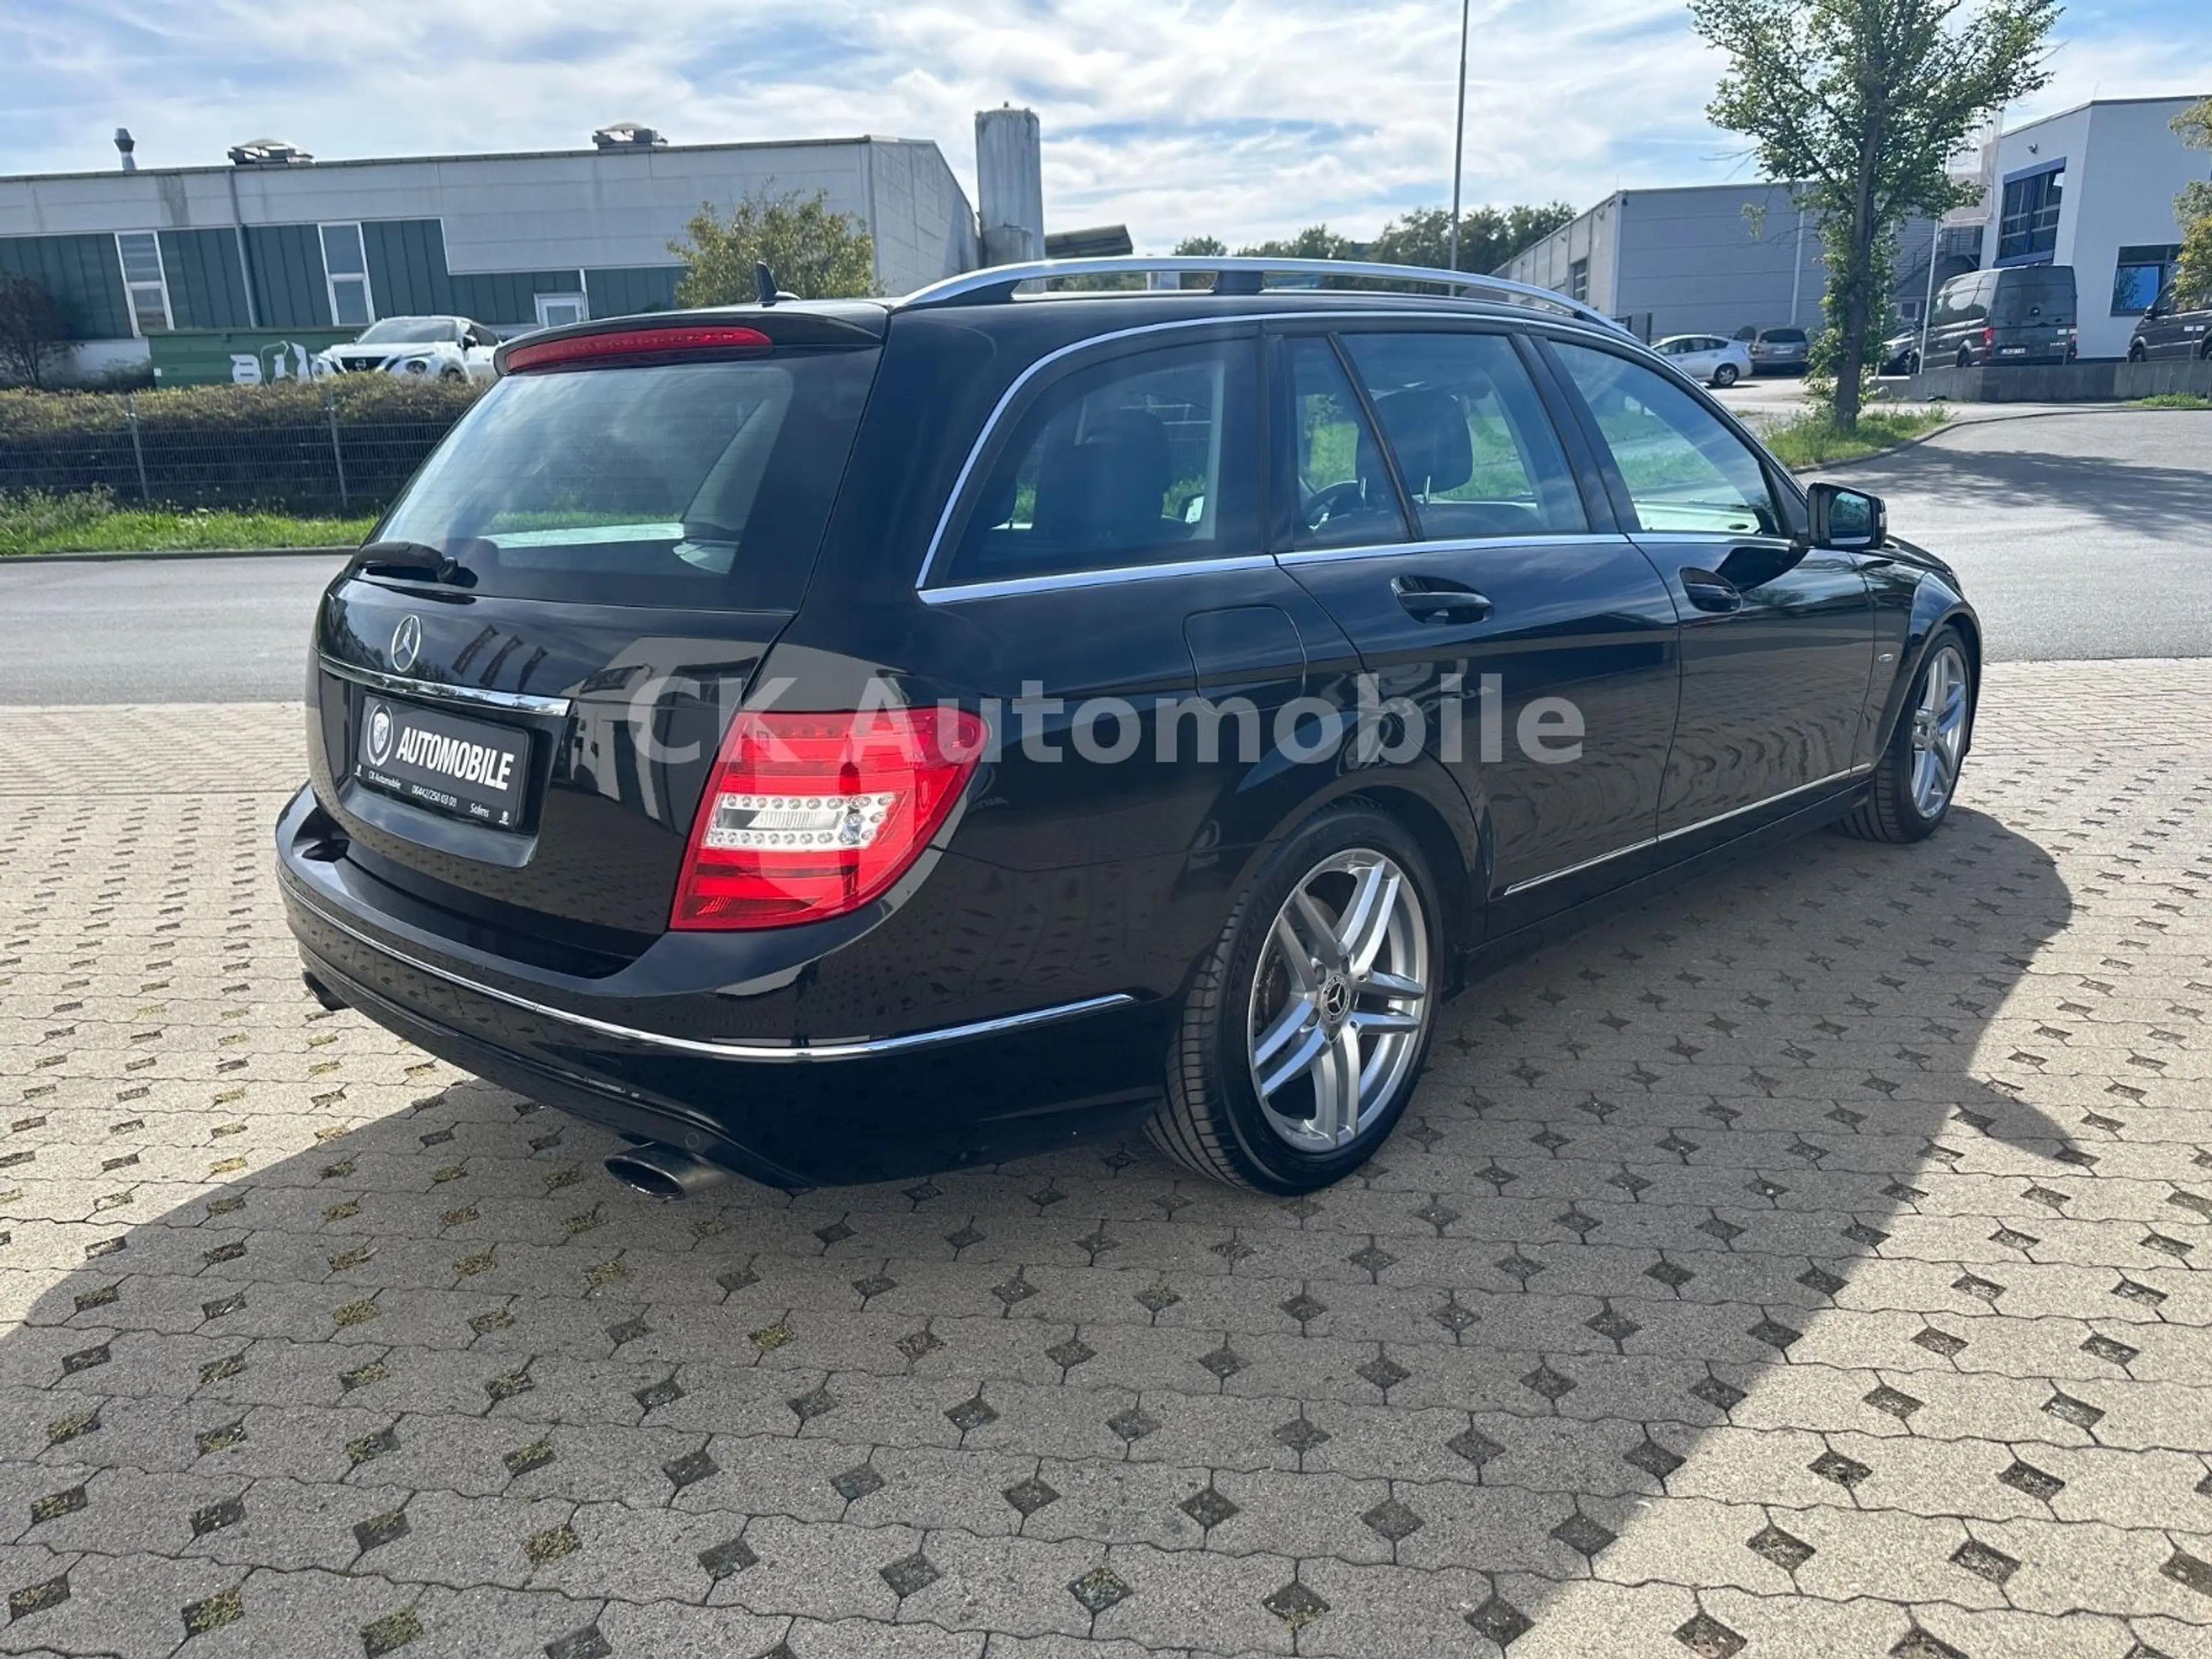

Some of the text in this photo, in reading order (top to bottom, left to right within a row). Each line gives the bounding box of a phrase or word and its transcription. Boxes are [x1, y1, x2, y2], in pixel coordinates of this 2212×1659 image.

[396, 727, 514, 790] AUTOMOBILE
[376, 774, 402, 789] Automobile
[469, 802, 490, 818] Solms
